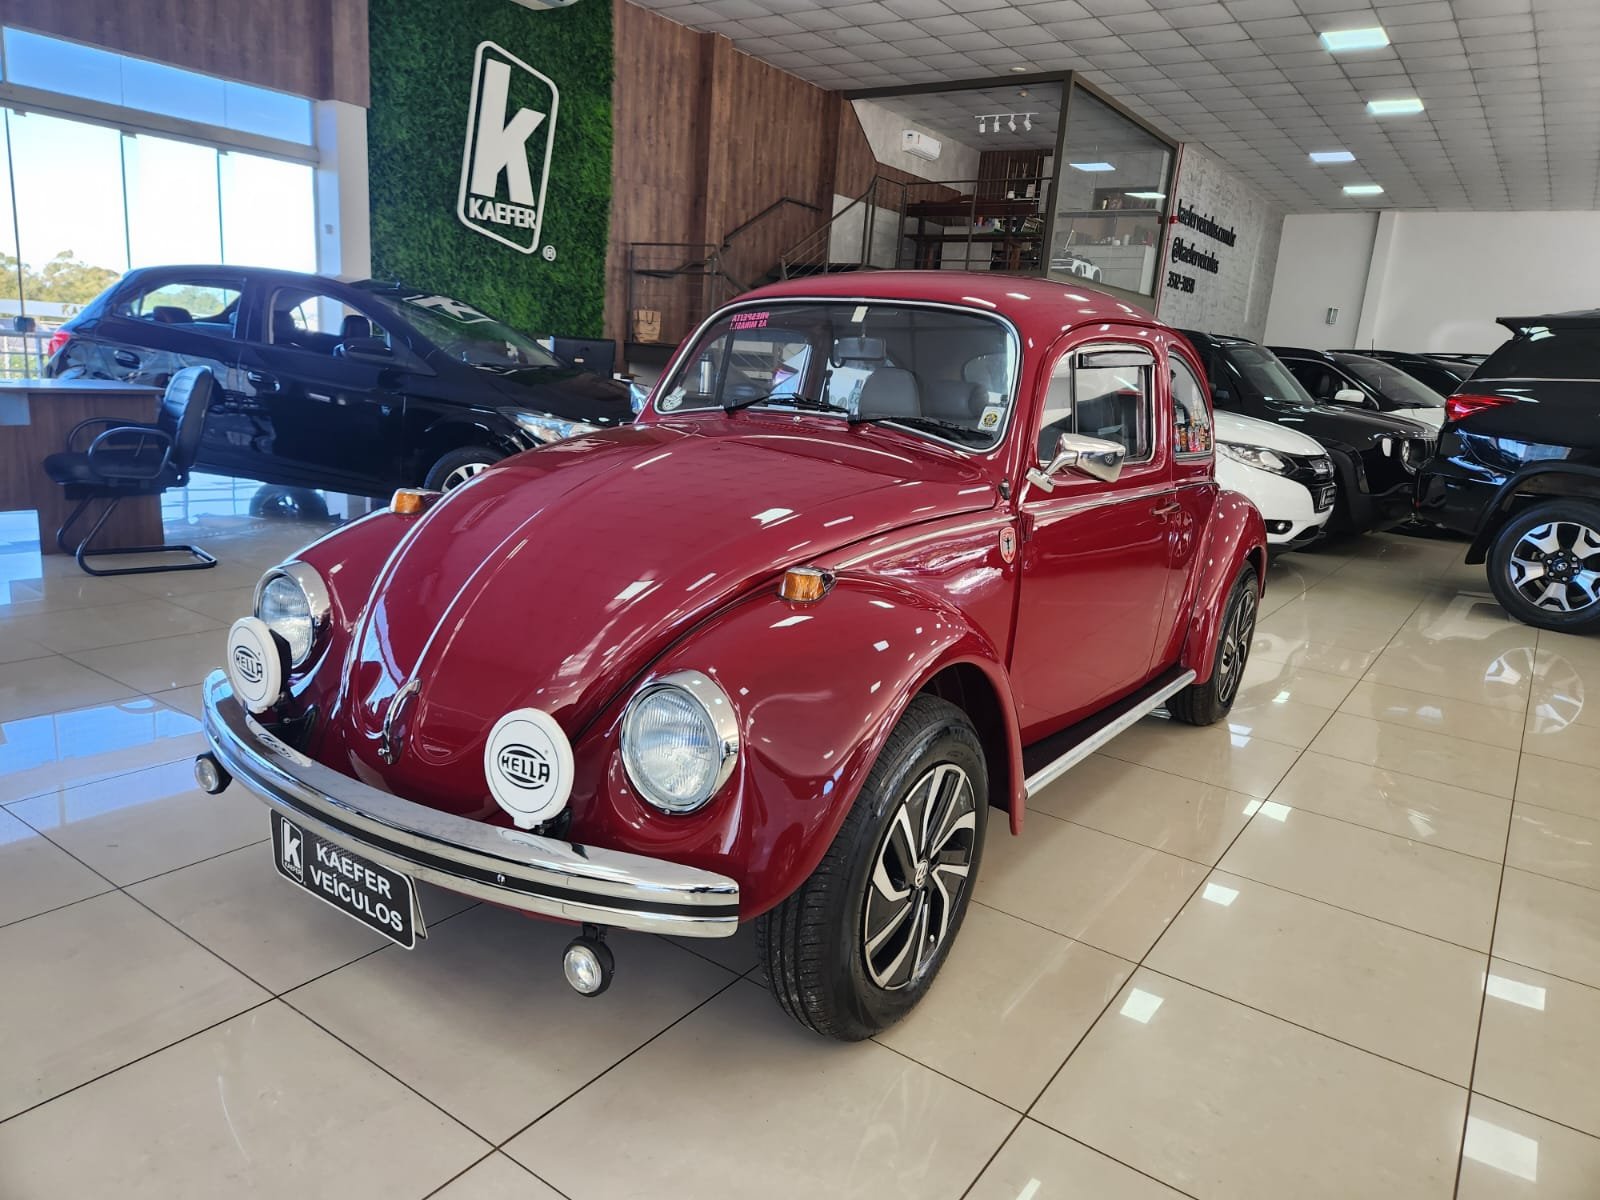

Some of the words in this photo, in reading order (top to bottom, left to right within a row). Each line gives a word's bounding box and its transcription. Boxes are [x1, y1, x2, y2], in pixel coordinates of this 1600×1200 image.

[469, 197, 537, 230] KAEFER
[235, 652, 264, 679] HELLA
[501, 754, 550, 783] HELLA
[316, 843, 393, 900] KAEFER
[309, 864, 404, 932] VEÍCULOS
